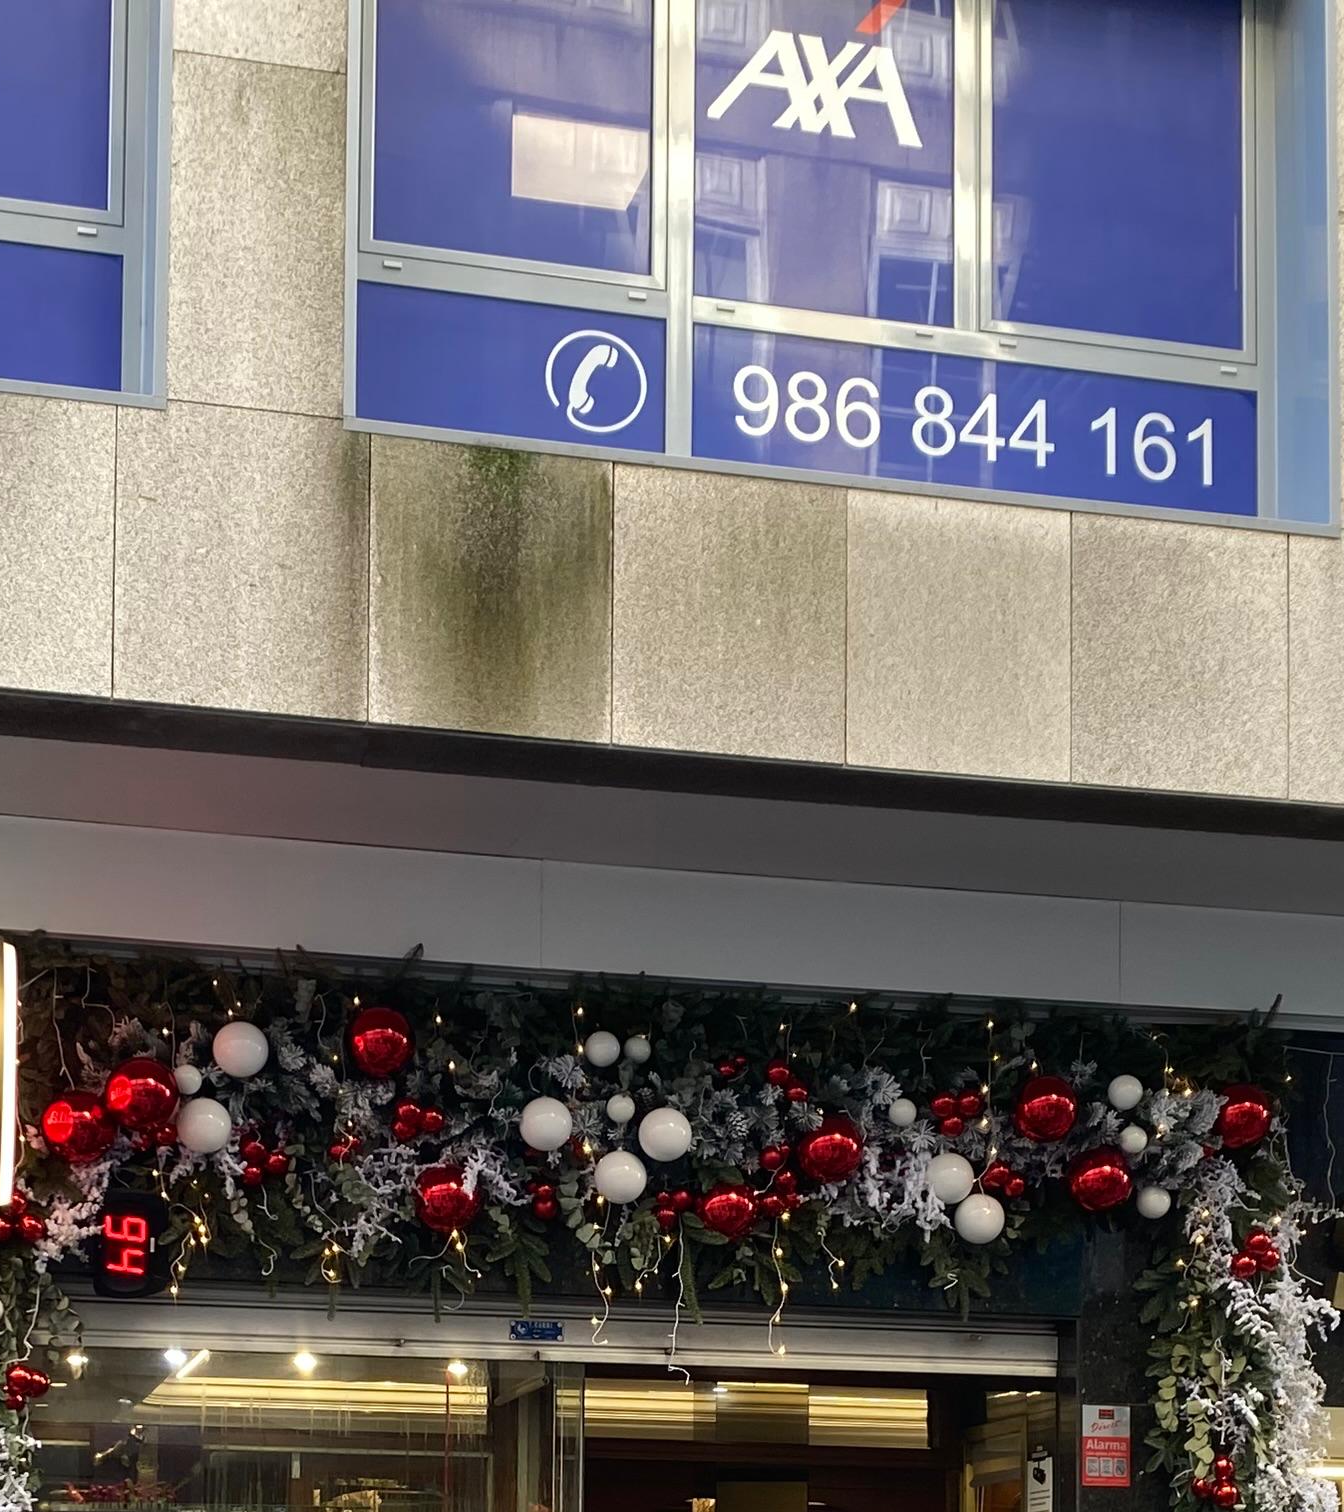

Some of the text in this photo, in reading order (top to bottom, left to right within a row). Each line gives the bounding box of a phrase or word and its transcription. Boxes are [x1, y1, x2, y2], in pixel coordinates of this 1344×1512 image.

[708, 30, 923, 149] AXA
[732, 365, 1215, 487] 986 844 161
[1086, 1438, 1128, 1451] Alarma
